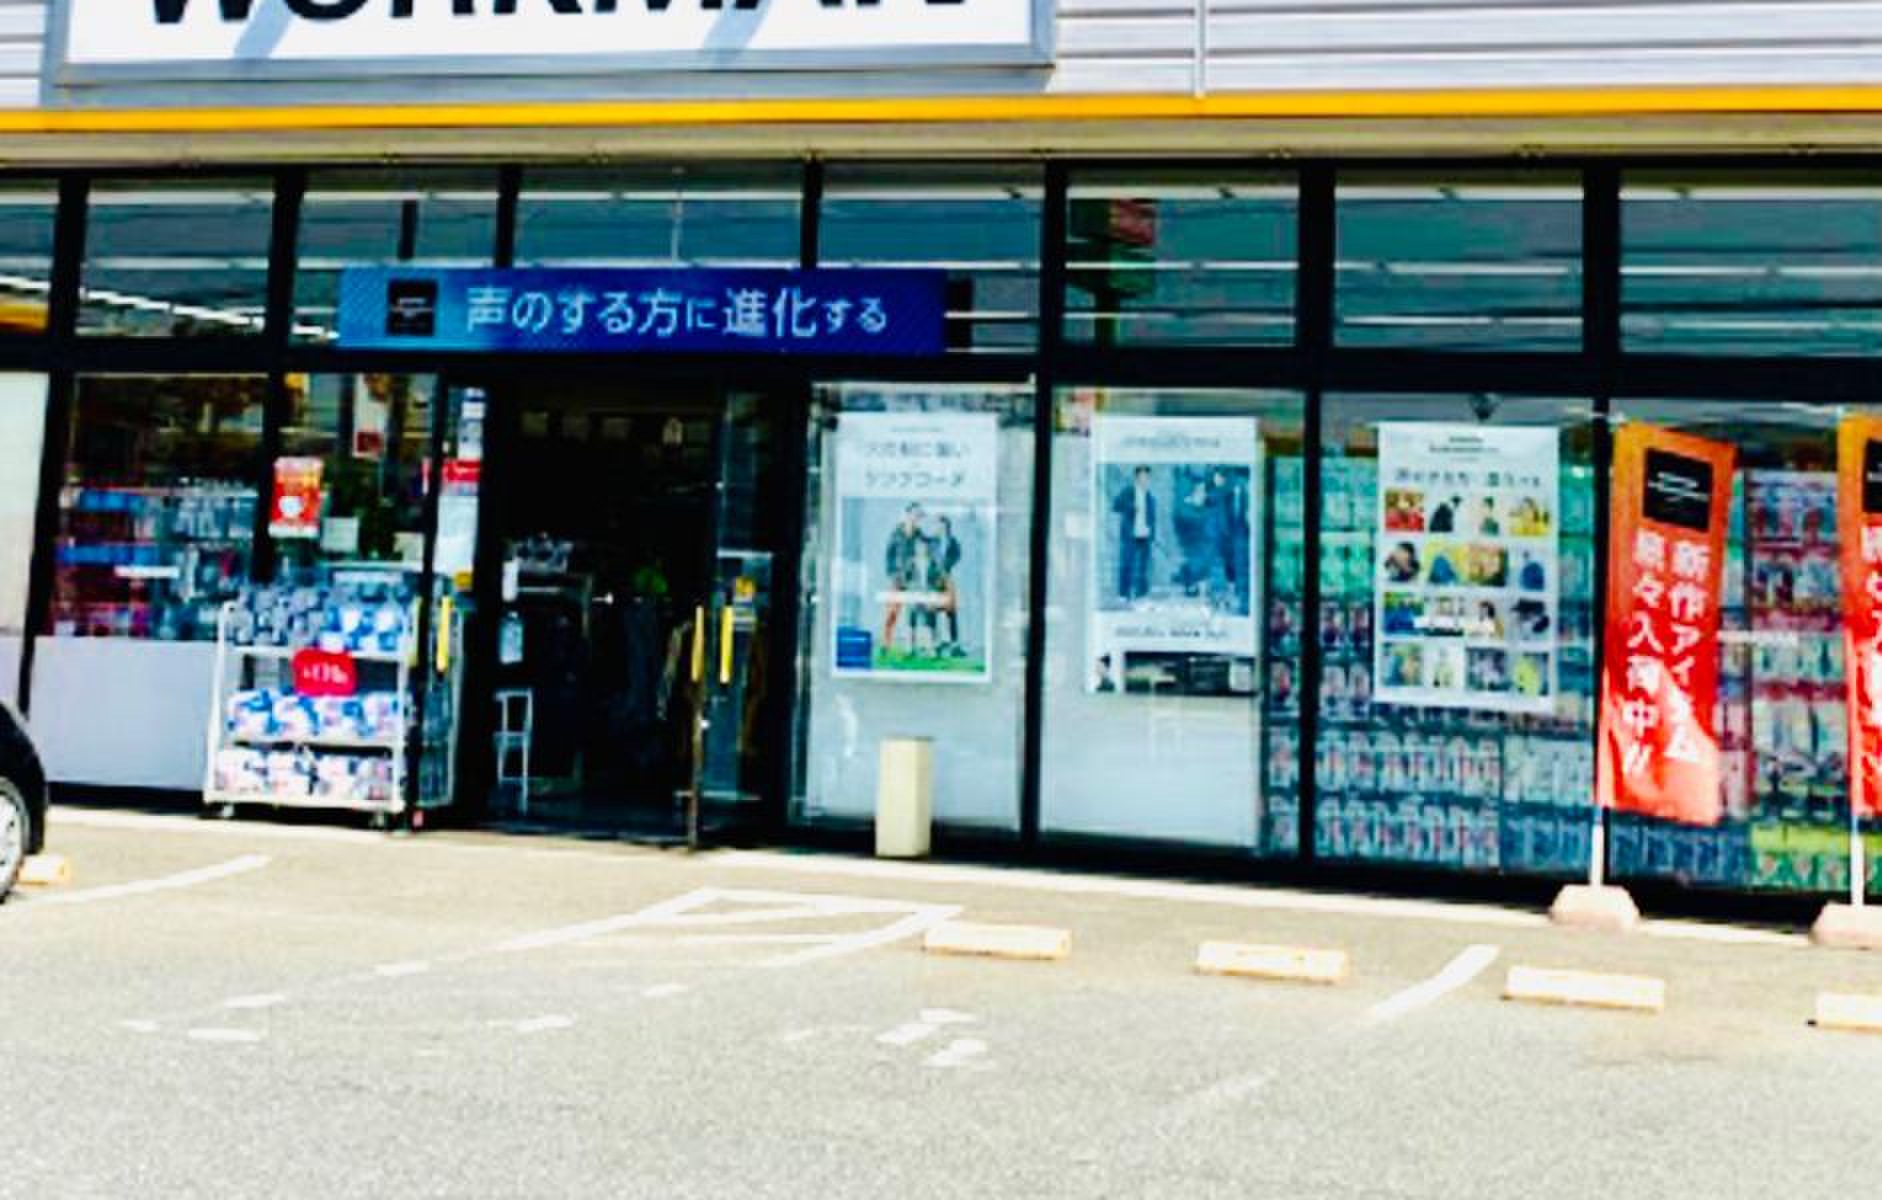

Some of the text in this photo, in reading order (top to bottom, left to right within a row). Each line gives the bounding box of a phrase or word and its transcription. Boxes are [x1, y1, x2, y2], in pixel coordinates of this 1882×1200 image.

[467, 287, 887, 337] 声のする方に進化する
